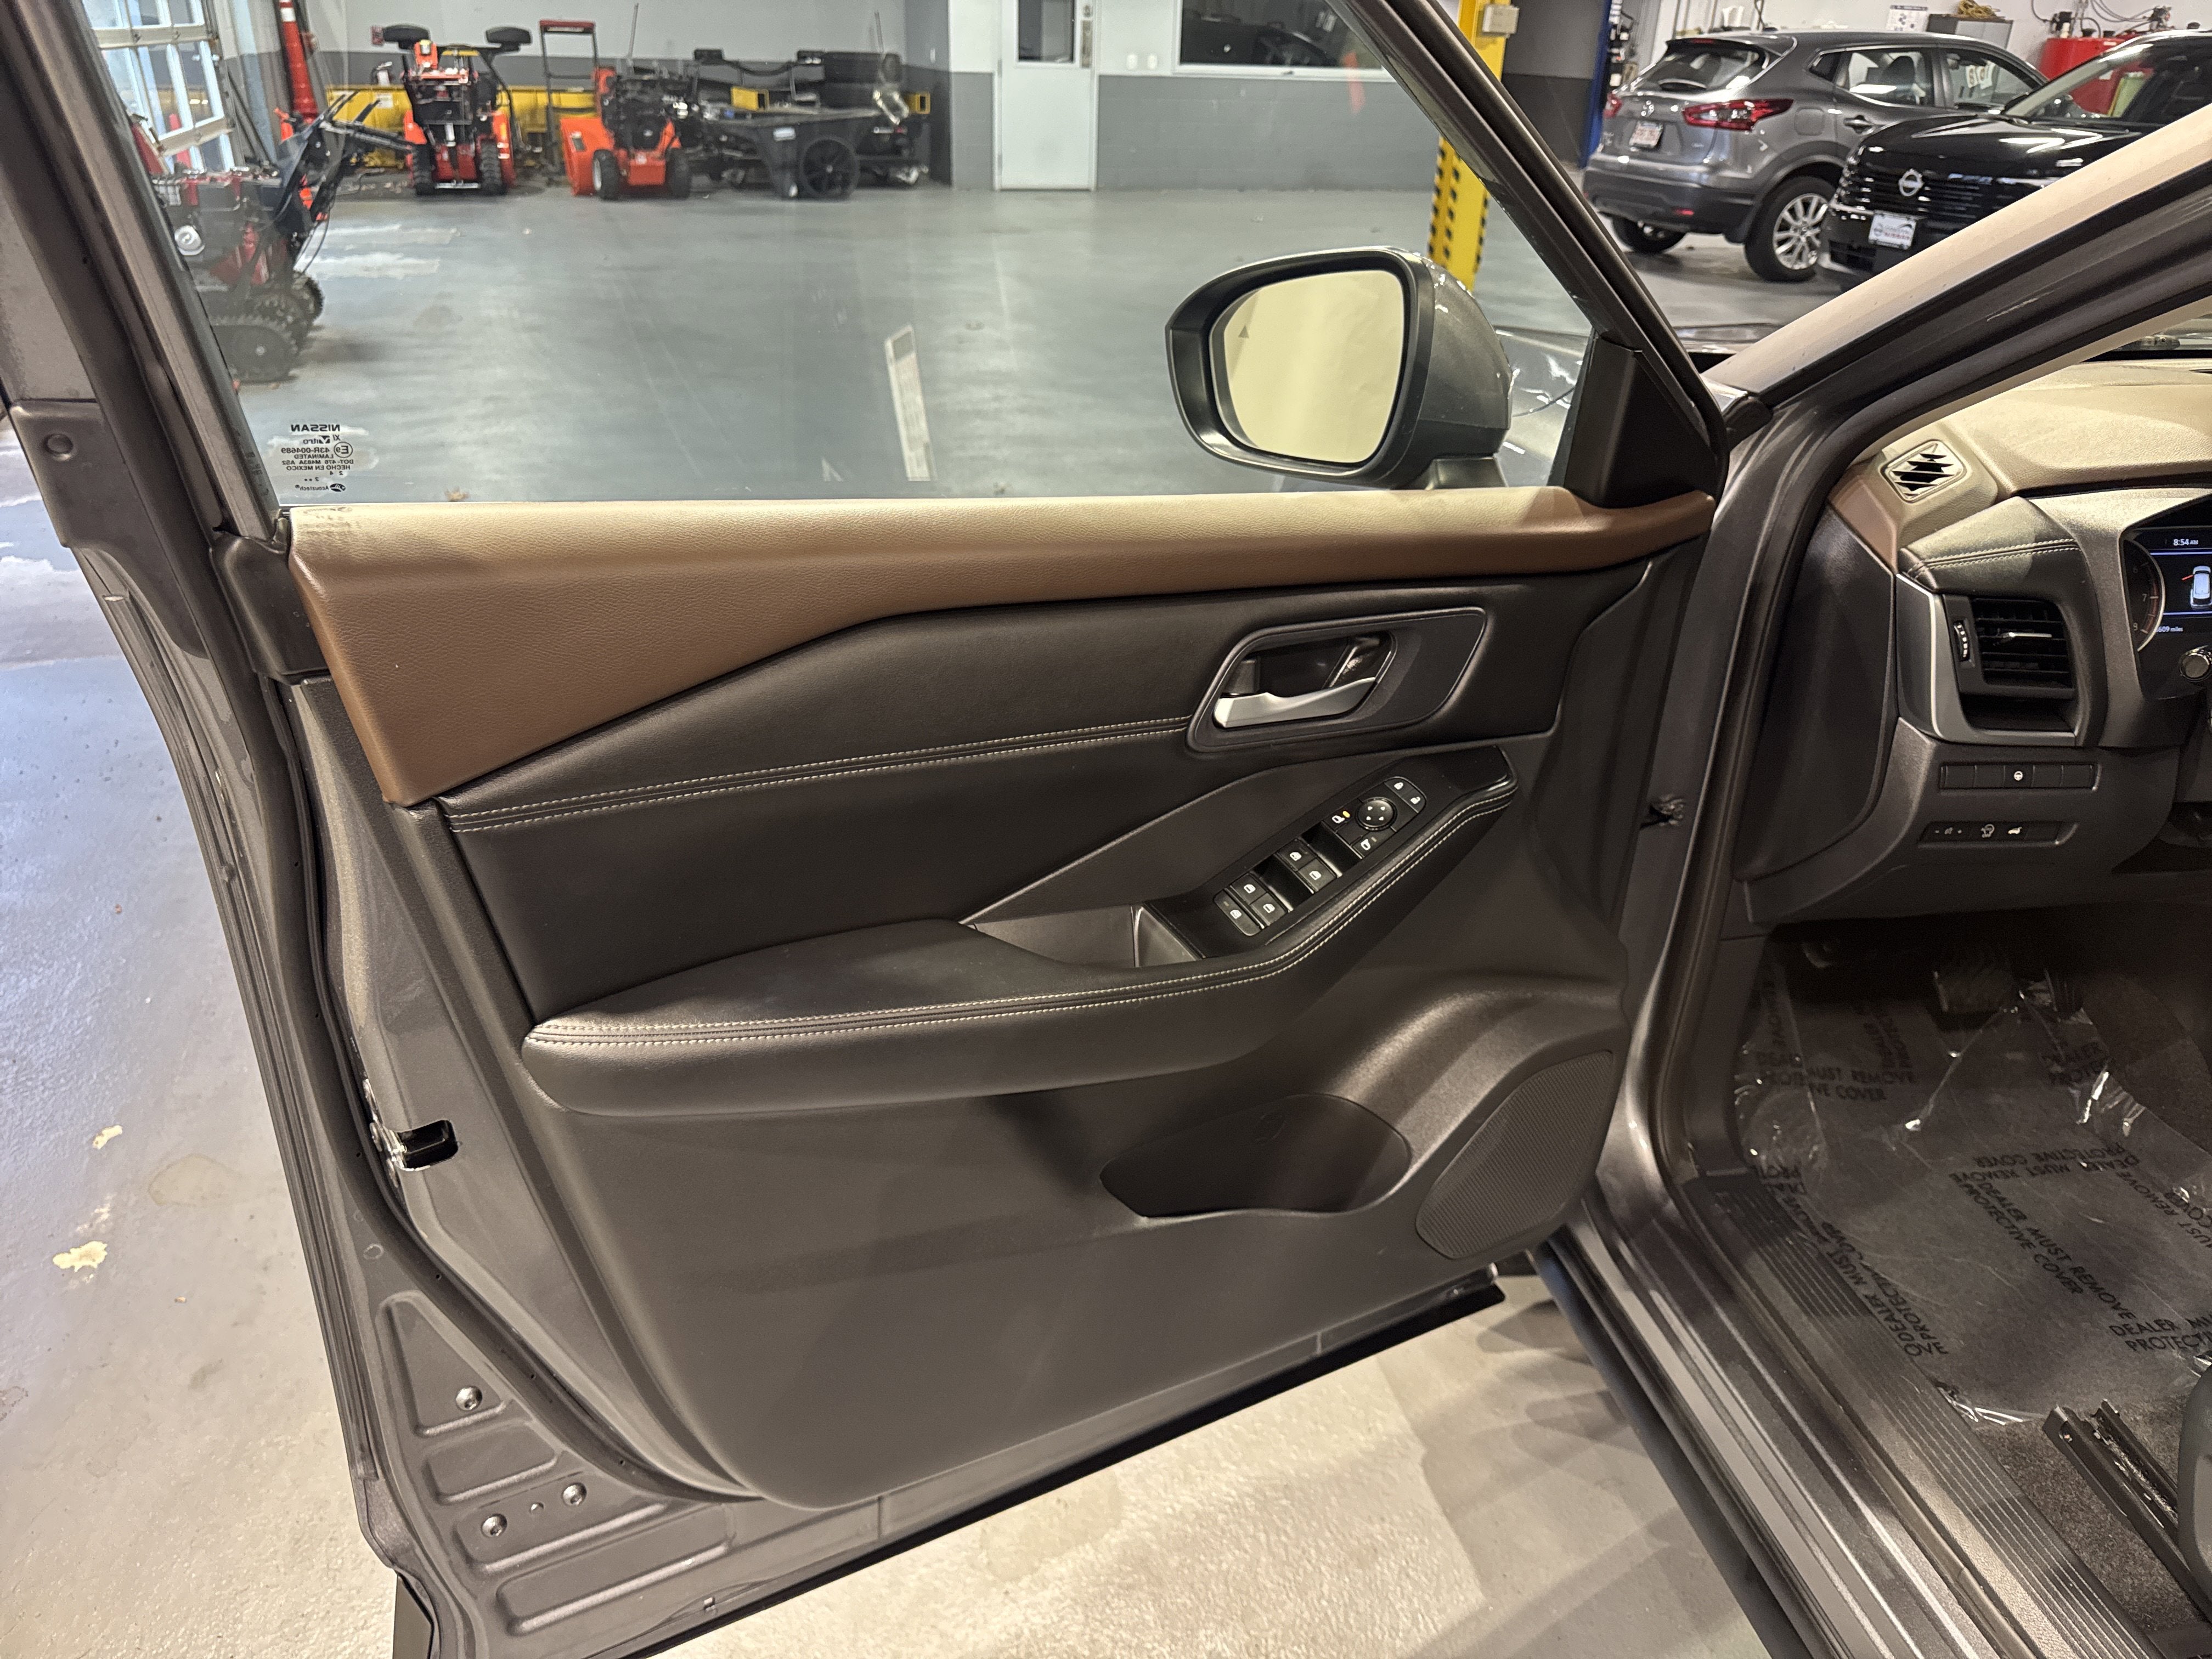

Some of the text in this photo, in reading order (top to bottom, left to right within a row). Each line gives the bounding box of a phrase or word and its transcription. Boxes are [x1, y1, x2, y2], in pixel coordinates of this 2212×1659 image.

[2142, 594, 2147, 602] 7
[2026, 1227, 2072, 1261] MUST
[2069, 1266, 2137, 1319] REMOVE
[2033, 1253, 2084, 1294] COVER
[2108, 1318, 2182, 1336] DEALER
